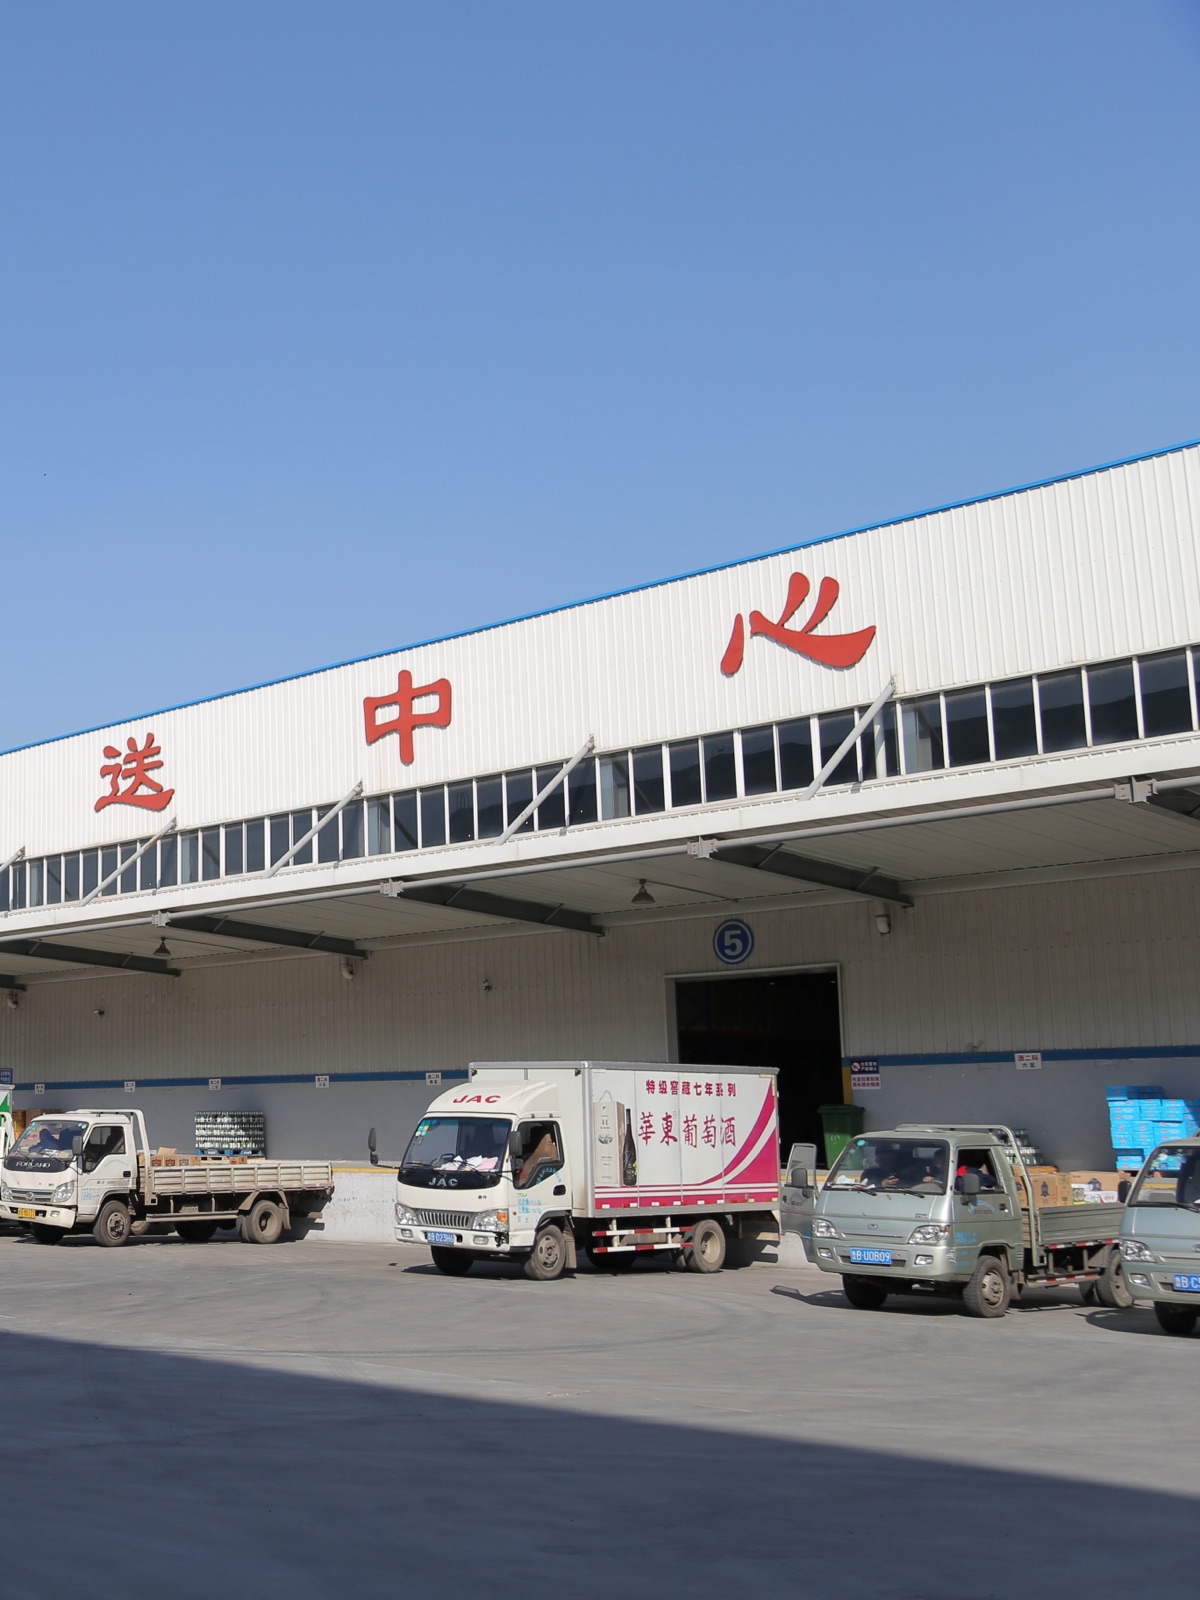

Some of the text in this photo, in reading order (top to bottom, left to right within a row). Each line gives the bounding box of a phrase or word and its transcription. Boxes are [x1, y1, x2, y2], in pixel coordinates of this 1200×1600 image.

[724, 930, 743, 956] 5
[1017, 1054, 1039, 1062] 酒二科
[645, 1079, 737, 1097] 特级窖藏七年系列
[452, 1095, 502, 1104] JAC
[638, 1111, 737, 1149] 華東葡萄酒
[428, 1177, 459, 1187] JAC
